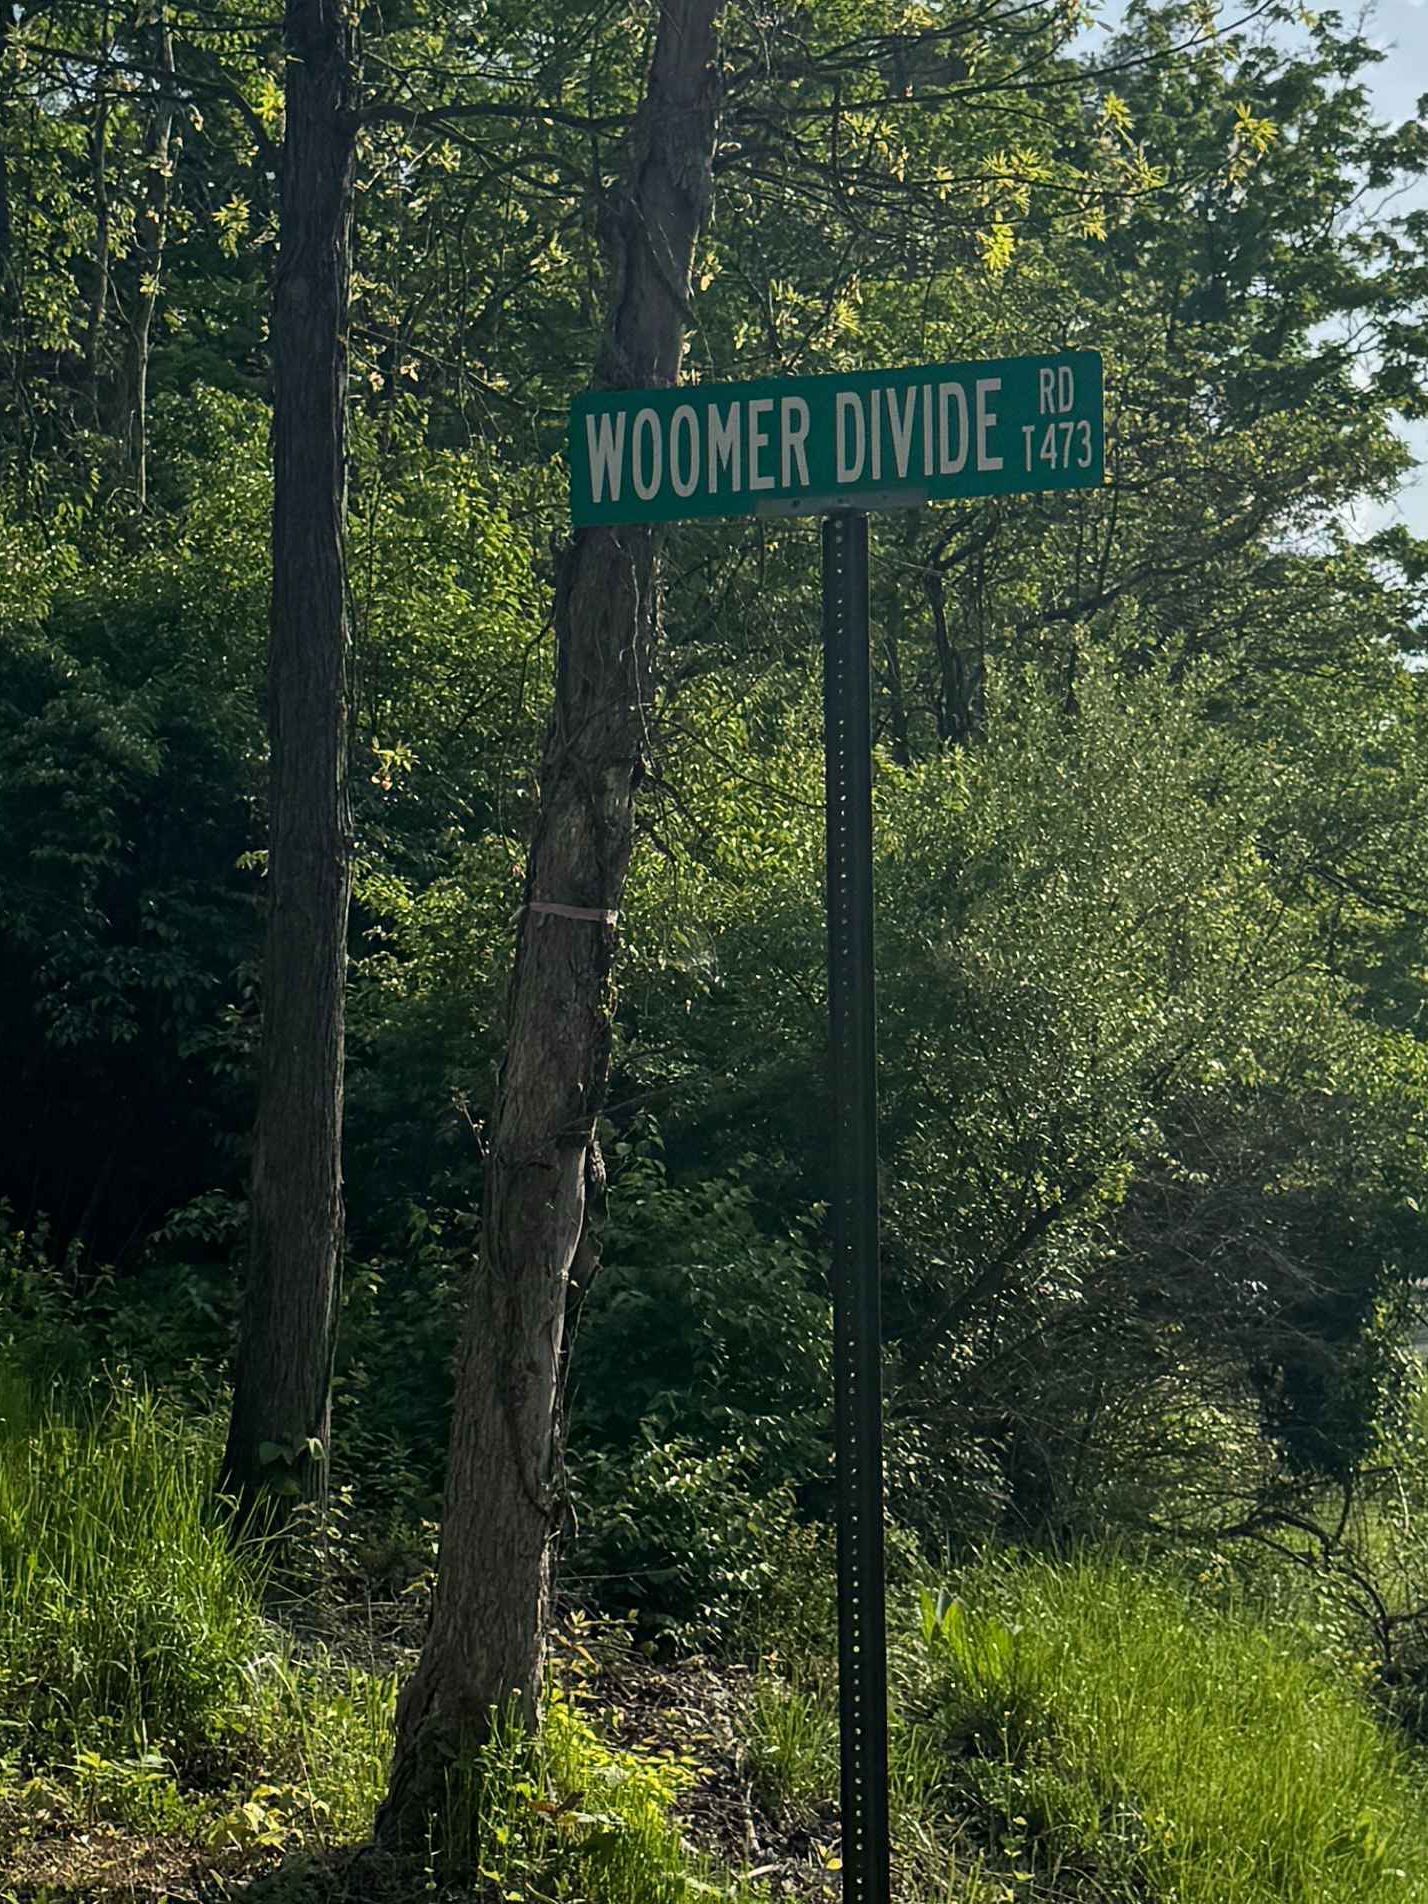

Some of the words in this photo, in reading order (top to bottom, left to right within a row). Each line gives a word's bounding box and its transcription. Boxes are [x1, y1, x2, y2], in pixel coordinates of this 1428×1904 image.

[1039, 365, 1075, 415] RD
[585, 396, 811, 504] WOOMER
[836, 378, 1004, 483] DIVIDE
[1021, 420, 1093, 473] T473
